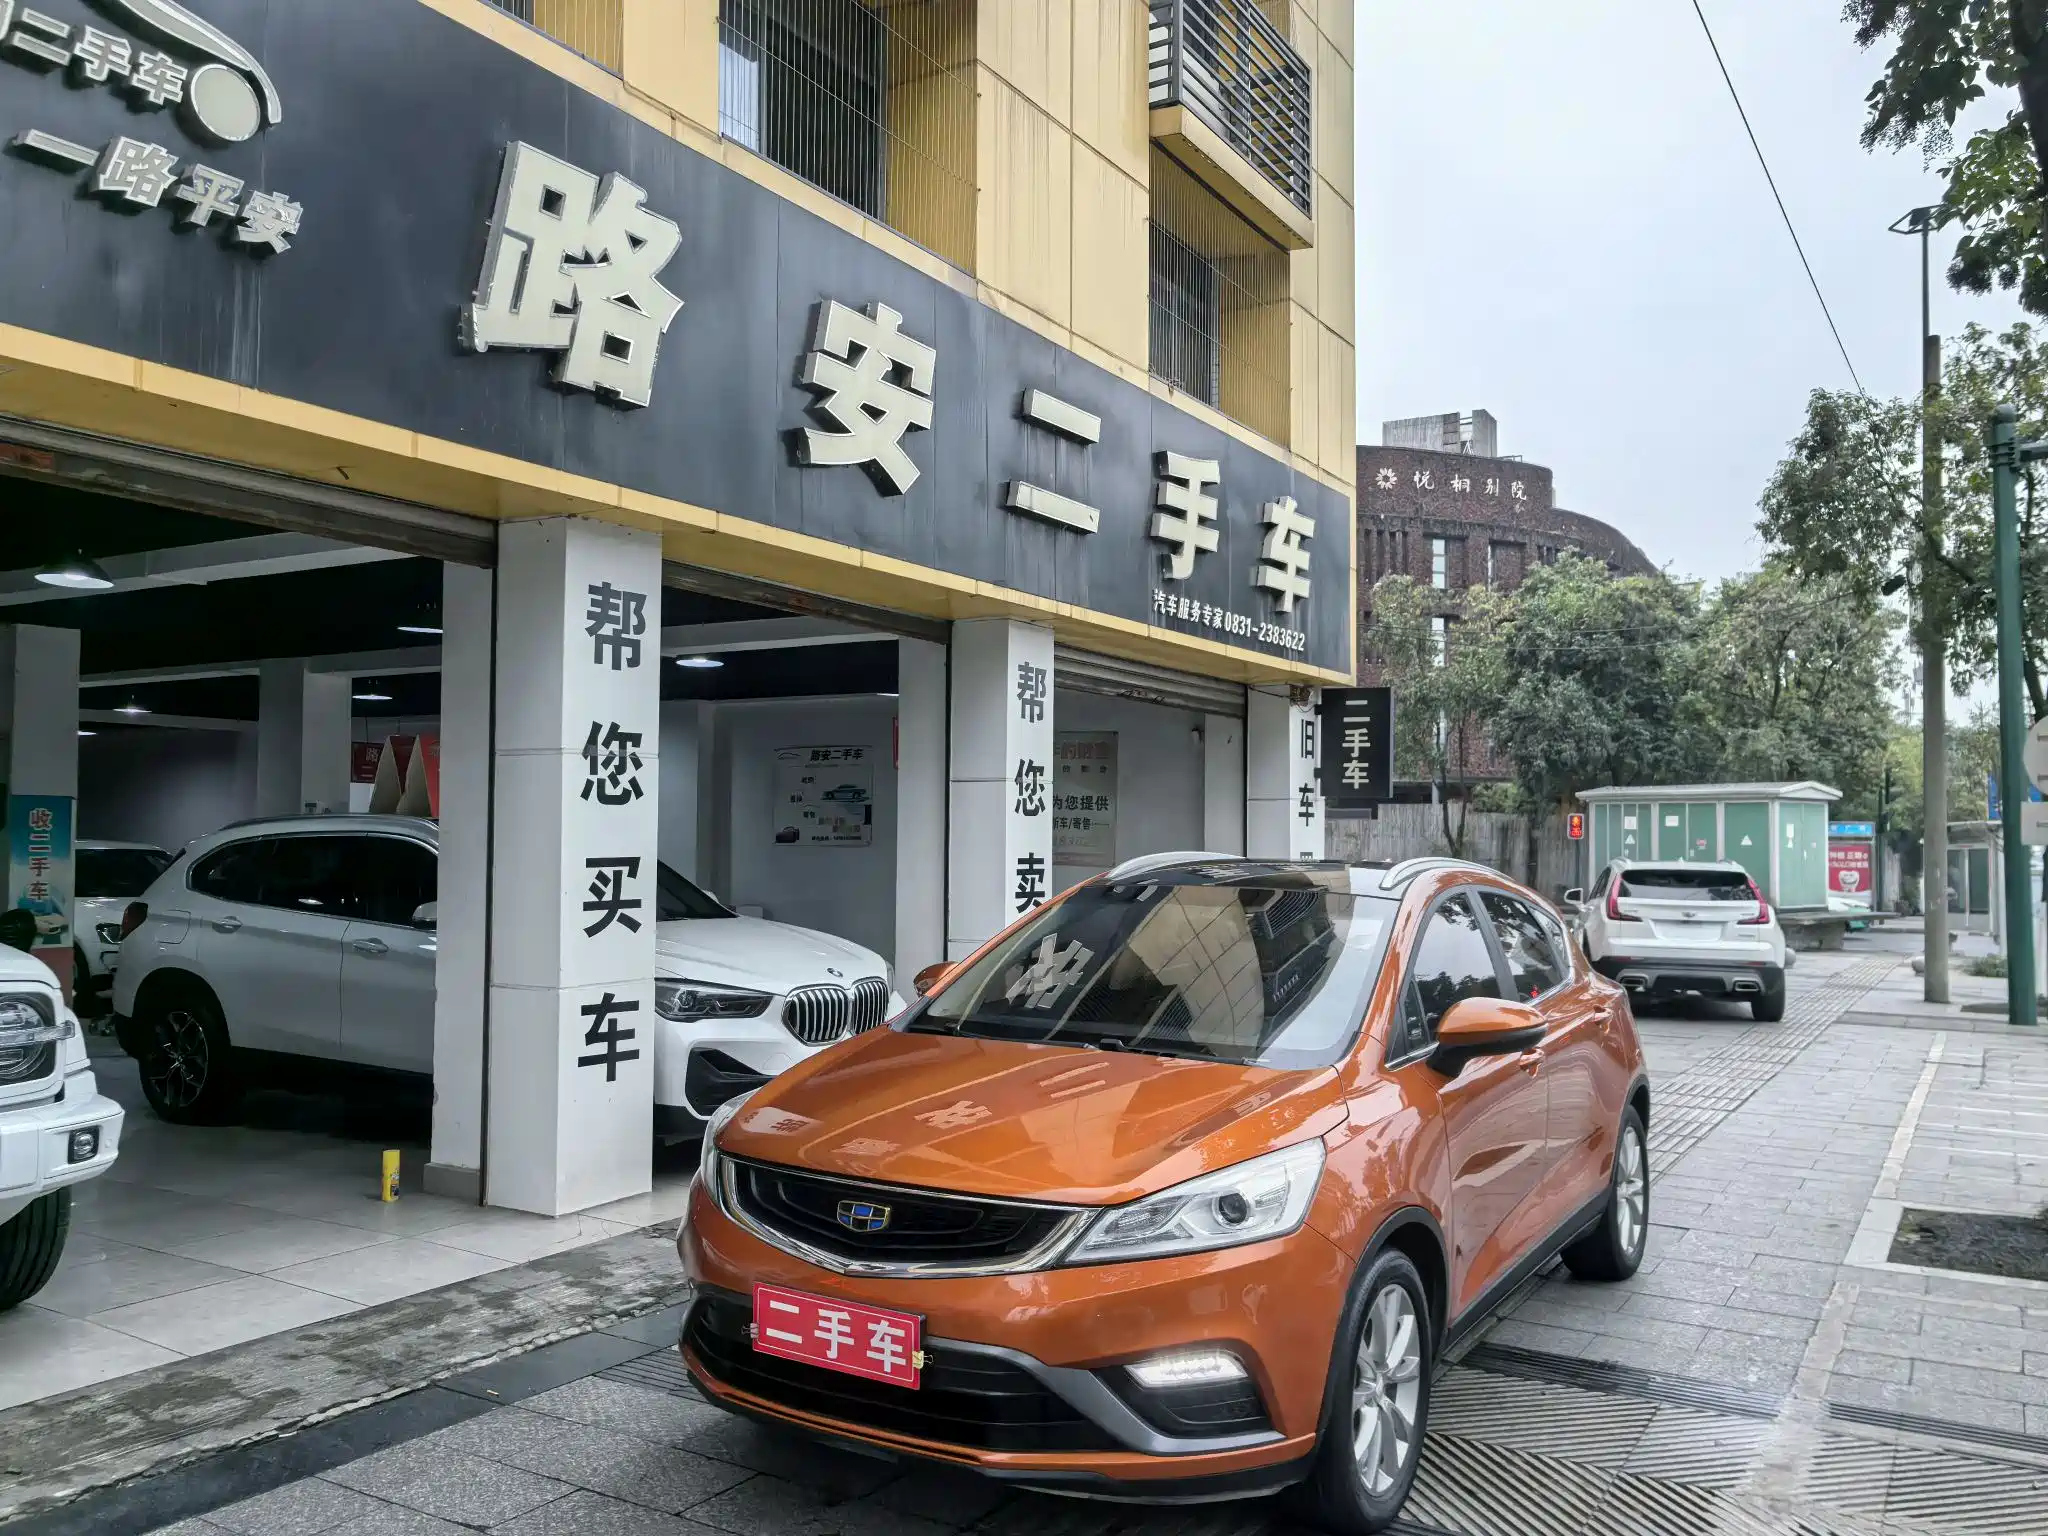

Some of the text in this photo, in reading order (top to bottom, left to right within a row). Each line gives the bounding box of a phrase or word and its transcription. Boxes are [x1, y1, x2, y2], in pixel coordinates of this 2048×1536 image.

[0, 0, 188, 105] 二手车
[24, 128, 303, 254] 一路平安
[464, 140, 1316, 613] 路安二手车
[1413, 470, 1527, 500] 悦桐别院
[1341, 699, 1371, 790] 二手车
[28, 808, 53, 900] 收二手车
[577, 581, 648, 1083] 帮您买车
[766, 1299, 907, 1373] 二手车
